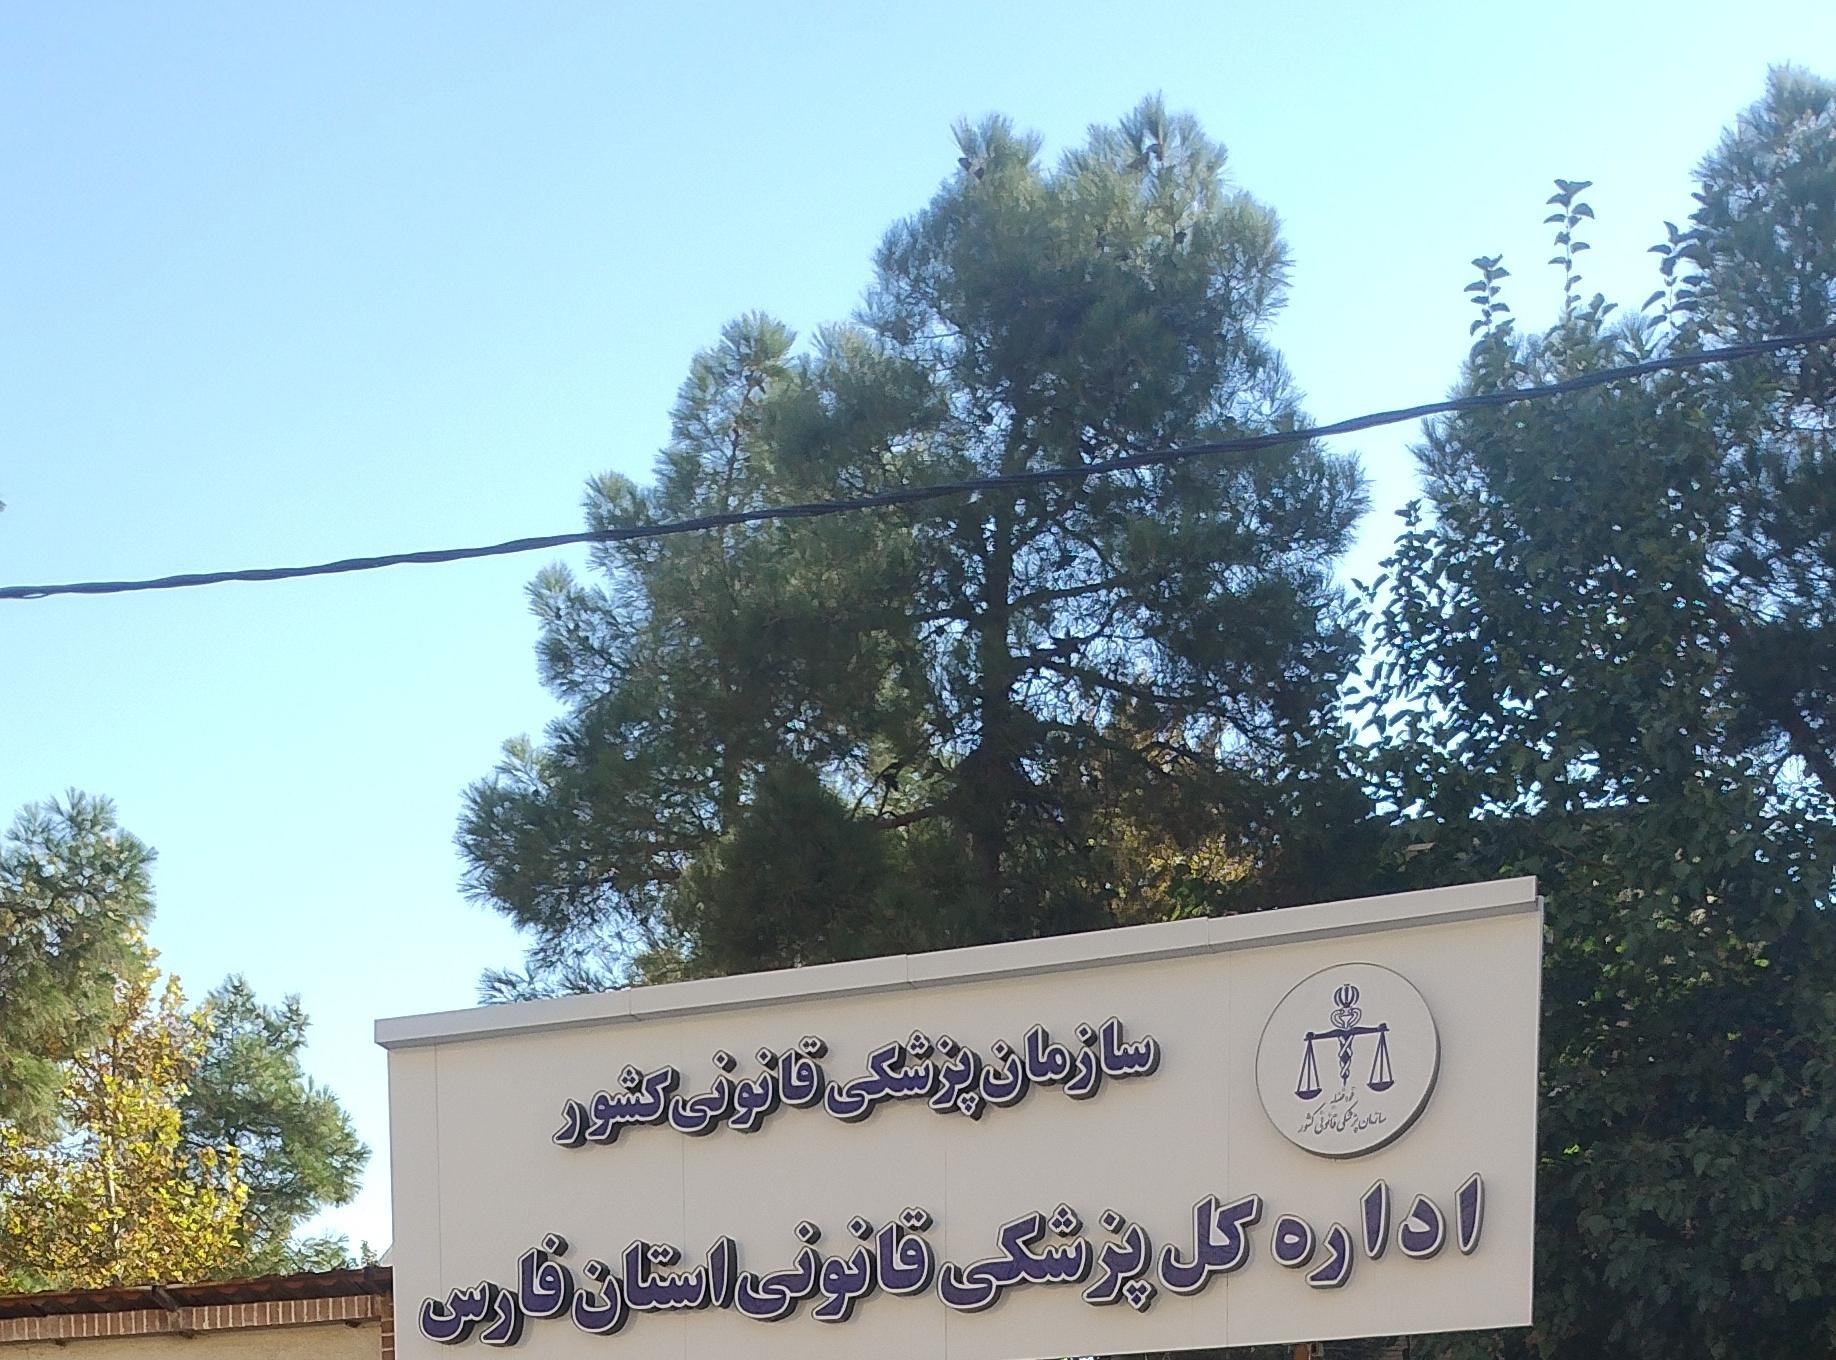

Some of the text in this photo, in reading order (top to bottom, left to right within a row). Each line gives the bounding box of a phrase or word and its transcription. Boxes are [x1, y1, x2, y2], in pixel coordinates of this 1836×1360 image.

[552, 1016, 1161, 1149] سازمان پزشکی قانونی کشور
[418, 1172, 1486, 1347] اداره کل پزشکی قانونی استان فارس
